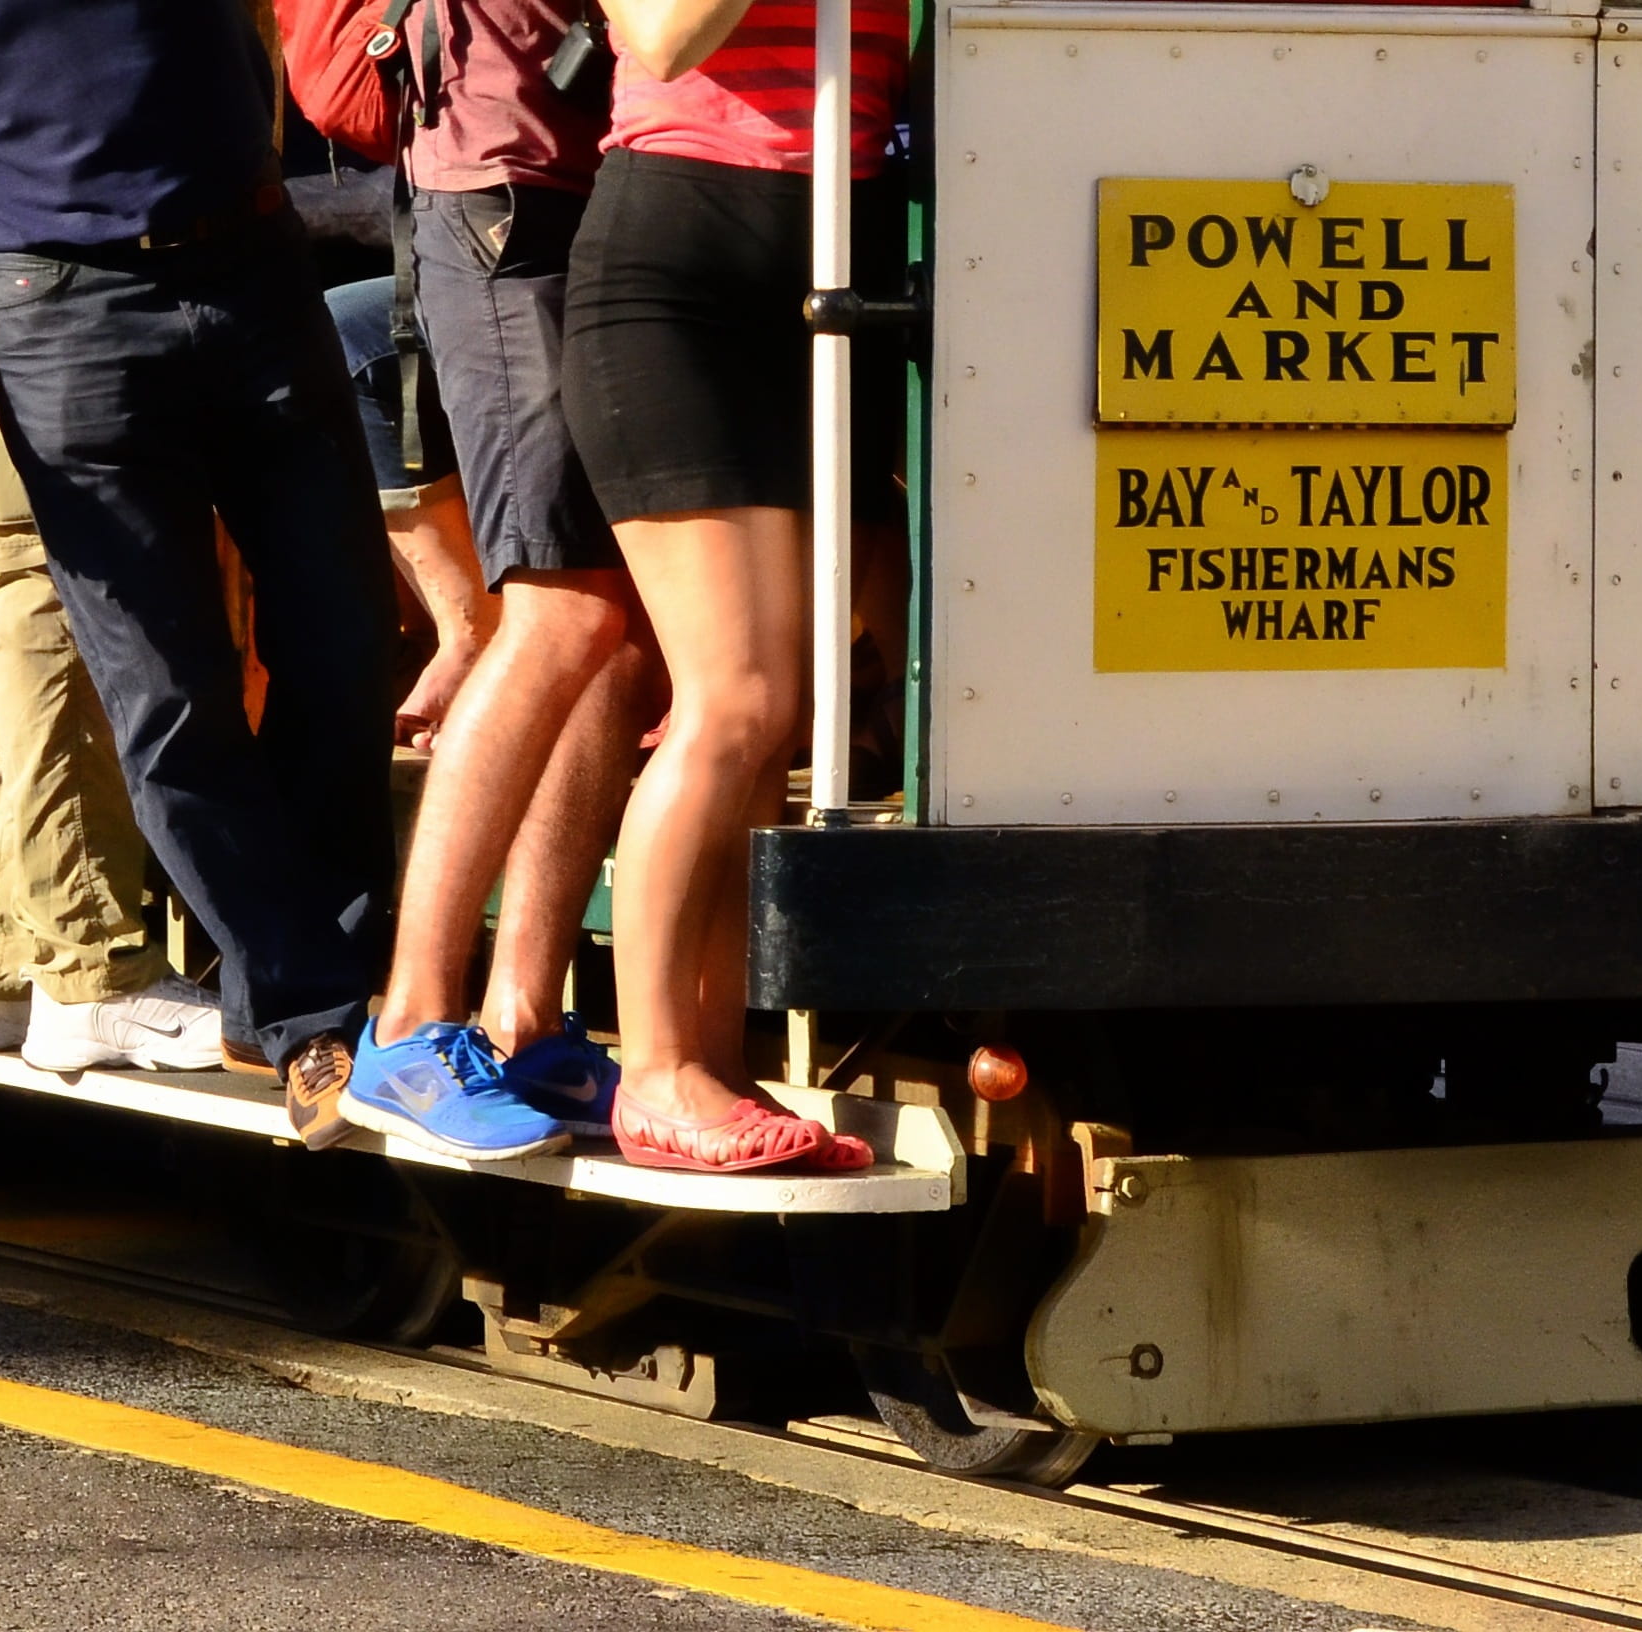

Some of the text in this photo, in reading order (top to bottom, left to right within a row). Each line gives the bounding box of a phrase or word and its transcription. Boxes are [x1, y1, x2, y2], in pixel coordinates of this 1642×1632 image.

[1128, 213, 1491, 271] POWELL
[1226, 280, 1404, 320] AND
[1122, 328, 1499, 383] MARKET
[1116, 466, 1216, 527] BAY
[1292, 465, 1490, 527] TAYLOR
[1148, 546, 1455, 591] FISHERMANS
[1223, 599, 1381, 641] WHARF
